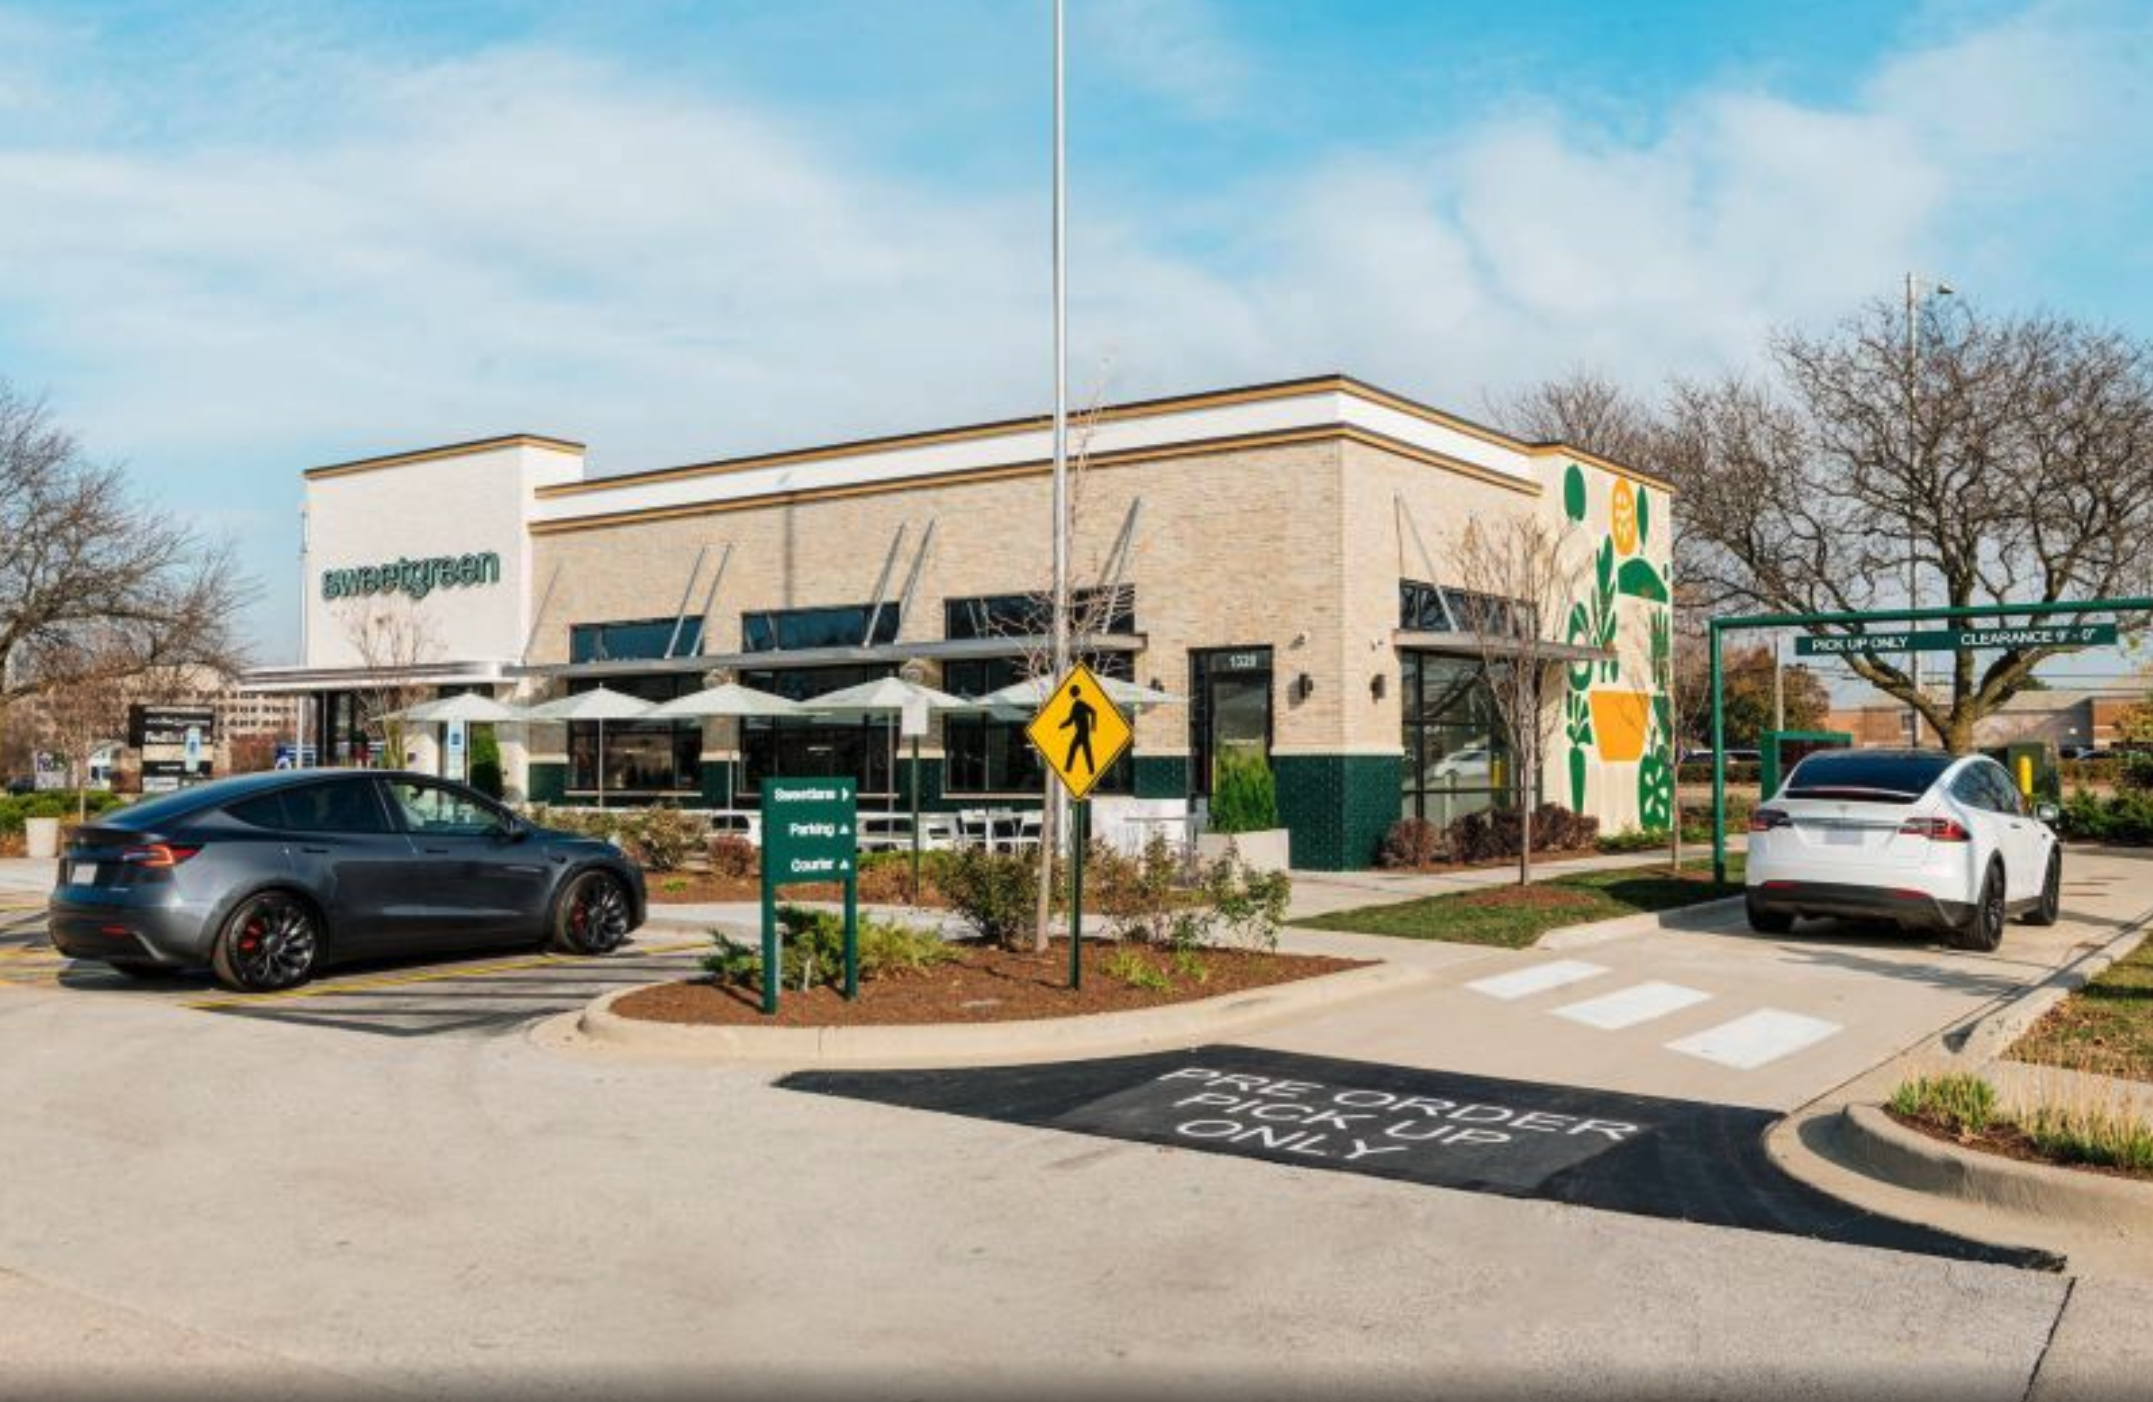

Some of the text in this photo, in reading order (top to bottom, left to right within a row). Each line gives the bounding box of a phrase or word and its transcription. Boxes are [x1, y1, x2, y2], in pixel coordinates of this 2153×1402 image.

[323, 552, 499, 599] sweetgreen
[1812, 635, 1909, 651] PICK UP ONLY
[1960, 631, 2052, 646] CLEARANCE
[790, 823, 835, 837] Parking
[791, 858, 834, 872] Courier
[1158, 1067, 1640, 1141] PRE ORDER
[1175, 1093, 1513, 1146] PICK UP
[1175, 1119, 1410, 1160] ONLY
